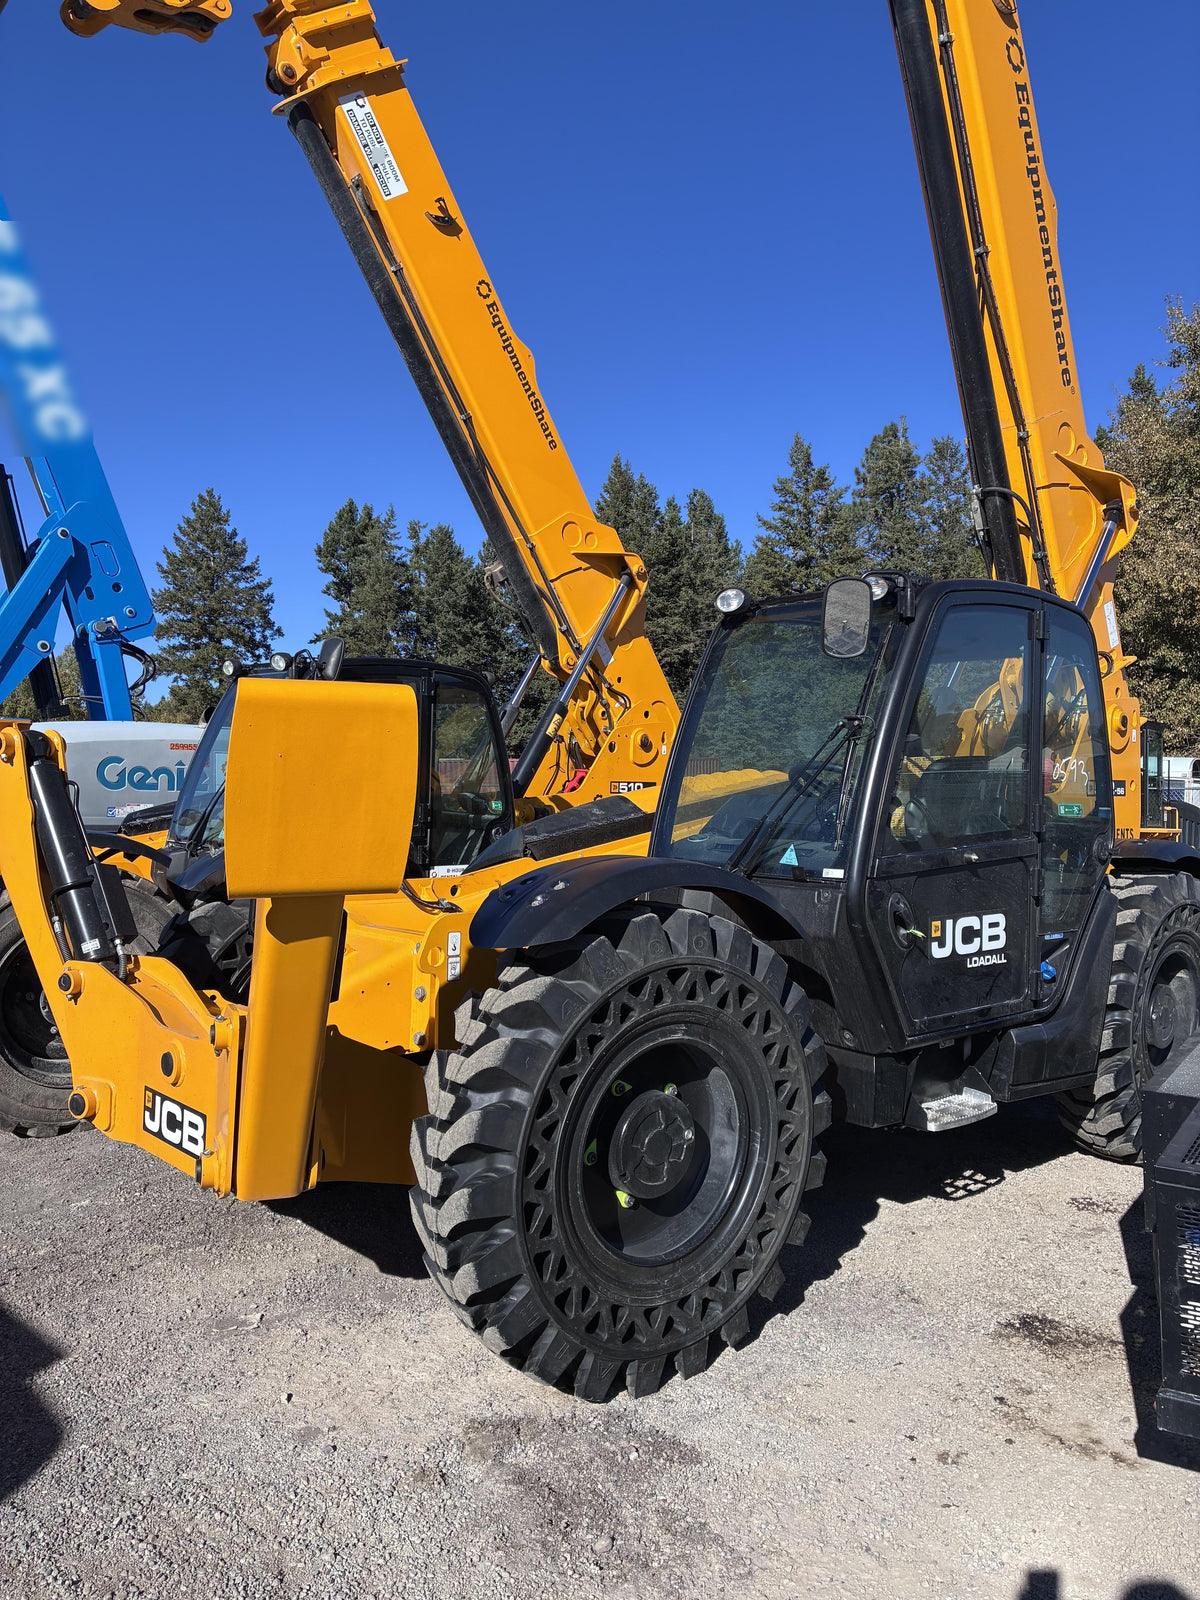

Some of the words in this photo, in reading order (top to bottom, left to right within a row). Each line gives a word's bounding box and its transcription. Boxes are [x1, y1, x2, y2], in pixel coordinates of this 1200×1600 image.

[360, 118, 368, 128] TO
[347, 110, 367, 145] DAMAGE
[374, 167, 392, 196] OCCUR
[365, 112, 375, 125] DO
[372, 126, 385, 143] NOT
[387, 160, 401, 183] BOOM
[486, 300, 558, 450] EquipmentShare
[619, 782, 643, 793] 510
[1053, 756, 1089, 787] 0593
[931, 913, 1007, 959] JCB
[967, 953, 1007, 968] LOADALL
[144, 1095, 205, 1157] JCB
